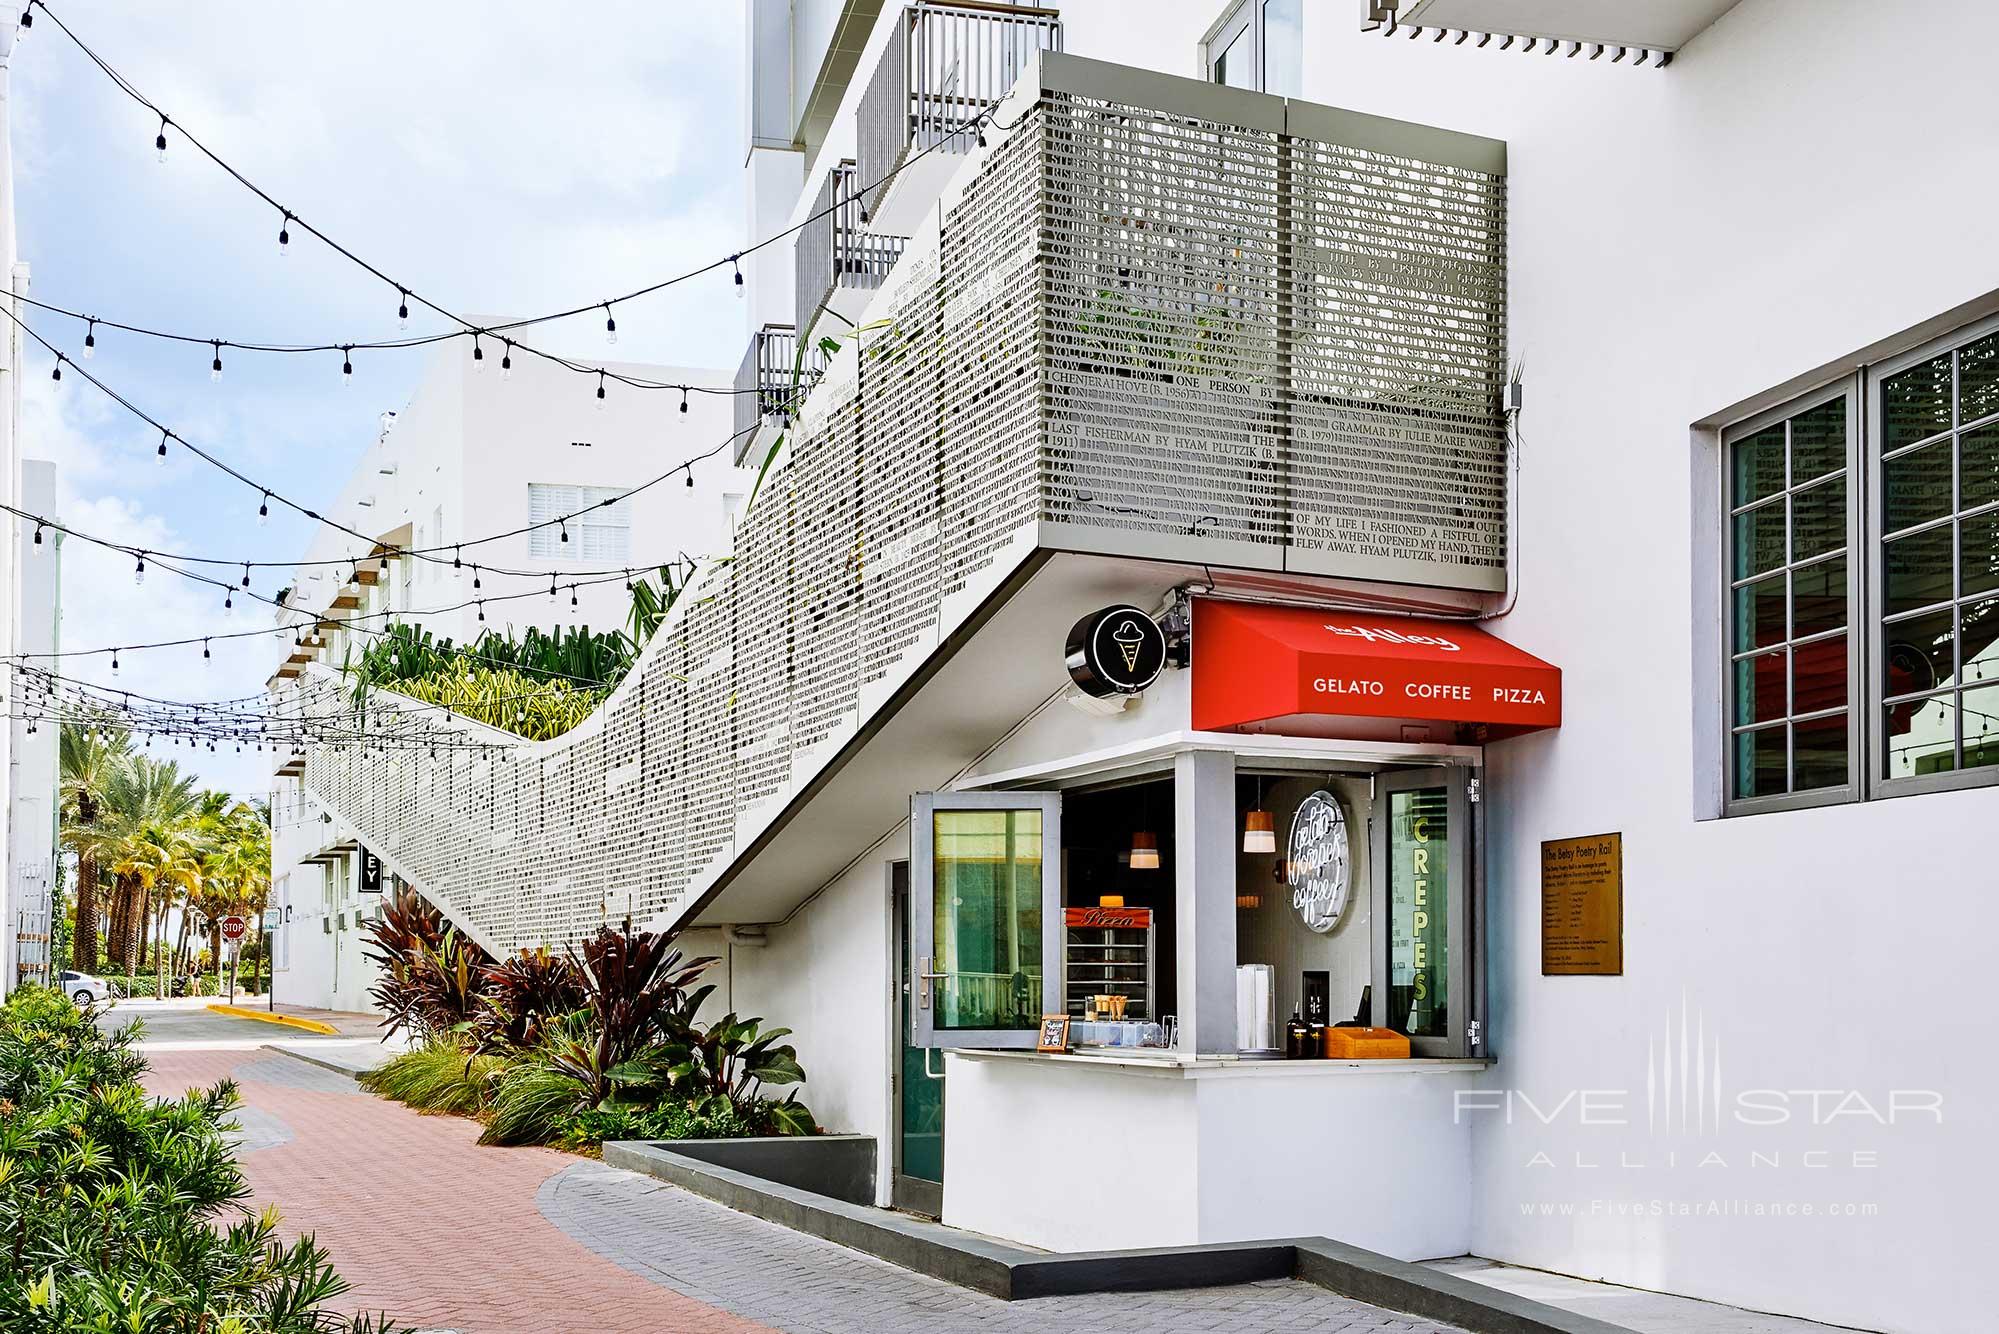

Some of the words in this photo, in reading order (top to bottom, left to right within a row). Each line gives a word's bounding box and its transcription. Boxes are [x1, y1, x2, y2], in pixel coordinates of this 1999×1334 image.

[1350, 171, 1371, 184] AND
[1398, 168, 1408, 179] AS
[1368, 258, 1380, 269] BY
[1369, 270, 1433, 289] MUHAMMAD
[1336, 289, 1368, 303] NIXON
[1340, 301, 1380, 316] GEORGE
[1052, 359, 1079, 371] NOW
[1176, 376, 1198, 387] ONE
[1209, 380, 1250, 394] PERSON
[1260, 387, 1273, 397] BY
[1052, 371, 1114, 388] CHENJERAI
[1116, 380, 1148, 393] HOVE
[1150, 385, 1162, 395] (B.
[1166, 387, 1188, 398] 1956)
[1052, 423, 1079, 435] LAST
[1085, 427, 1149, 443] FISHERMAN
[1155, 436, 1168, 446] BY
[1175, 438, 1206, 450] HYAM
[1212, 443, 1256, 456] PLUTZIK
[1262, 449, 1274, 458] (B.
[1052, 436, 1078, 447] 1911)
[1253, 435, 1274, 446] THE
[1296, 428, 1308, 439] (B.
[1311, 430, 1332, 442] 1979)
[1332, 421, 1385, 436] GRAMMAR
[1389, 428, 1400, 438] BY
[1404, 430, 1430, 442] JULIE
[1434, 434, 1465, 446] MARIE
[1469, 438, 1496, 450] WADE
[1296, 514, 1309, 524] OF
[1314, 516, 1330, 526] MY
[1336, 518, 1356, 529] LIFE
[1362, 521, 1364, 530] I
[1370, 522, 1425, 536] FASHIONED
[1431, 528, 1437, 537] A
[1442, 529, 1479, 541] FISTFUL
[1484, 533, 1496, 543] OF
[1476, 521, 1496, 531] OUT
[1296, 526, 1335, 539] WORDS.
[1339, 531, 1369, 542] WHEN
[1373, 534, 1376, 543] I
[1378, 535, 1417, 547] OPENED
[1421, 539, 1436, 549] MY
[1438, 541, 1468, 552] HAND,
[1471, 544, 1496, 555] THEY
[1296, 539, 1323, 550] FLEW
[1327, 542, 1356, 553] AWAY.
[1360, 545, 1389, 556] HYAM
[1393, 548, 1436, 561] PLUTZIK,
[1352, 625, 1462, 652] Alley
[1314, 678, 1384, 695] GELATO
[1405, 684, 1472, 700] COFFEE
[1493, 688, 1546, 704] PIZZA
[1545, 848, 1556, 860] The
[1558, 847, 1574, 862] Betsy
[1576, 845, 1597, 860] Poetry
[1598, 841, 1612, 855] Rail
[1082, 909, 1135, 927] Pizza
[1412, 817, 1430, 1002] CREPES
[224, 924, 244, 932] STOP
